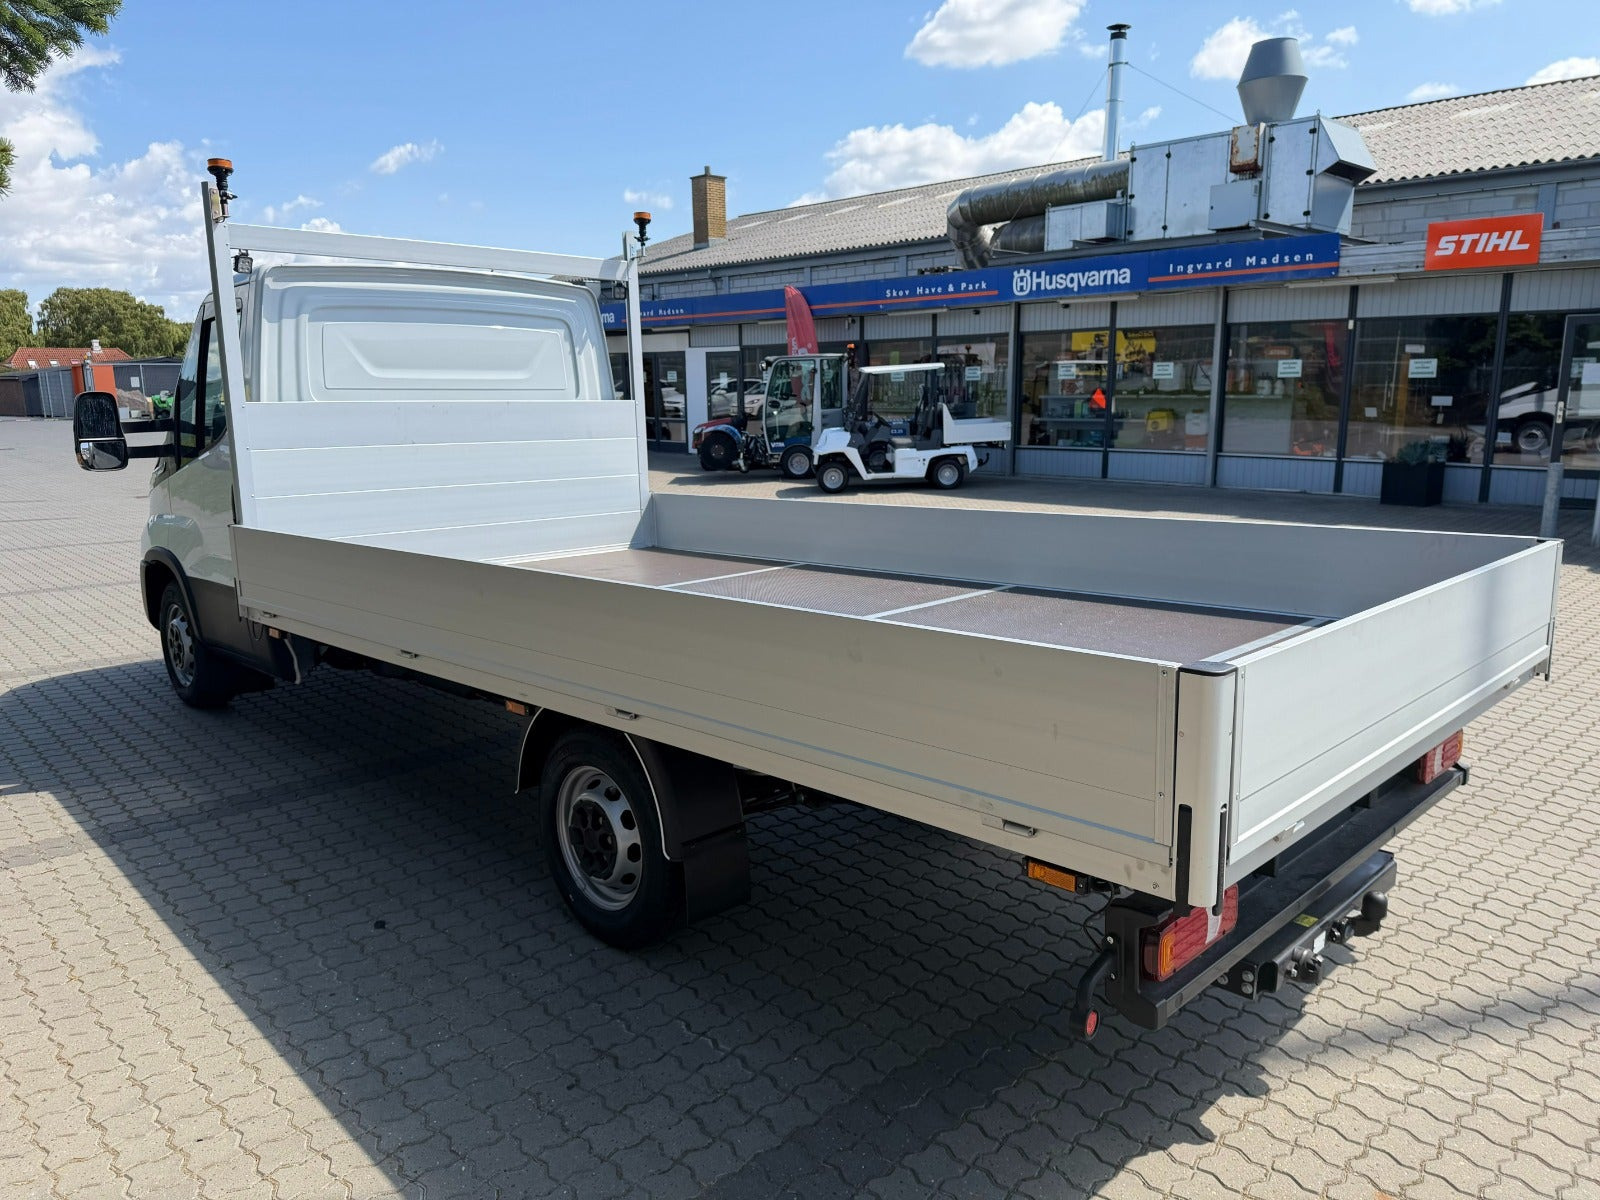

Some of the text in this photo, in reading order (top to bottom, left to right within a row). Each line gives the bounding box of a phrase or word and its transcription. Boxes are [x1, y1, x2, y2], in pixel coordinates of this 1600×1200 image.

[1435, 229, 1530, 256] STIHL
[1169, 252, 1314, 274] Ingvard Madsen
[885, 281, 987, 298] Skov Have & Park
[1031, 267, 1131, 291] Husqvarna
